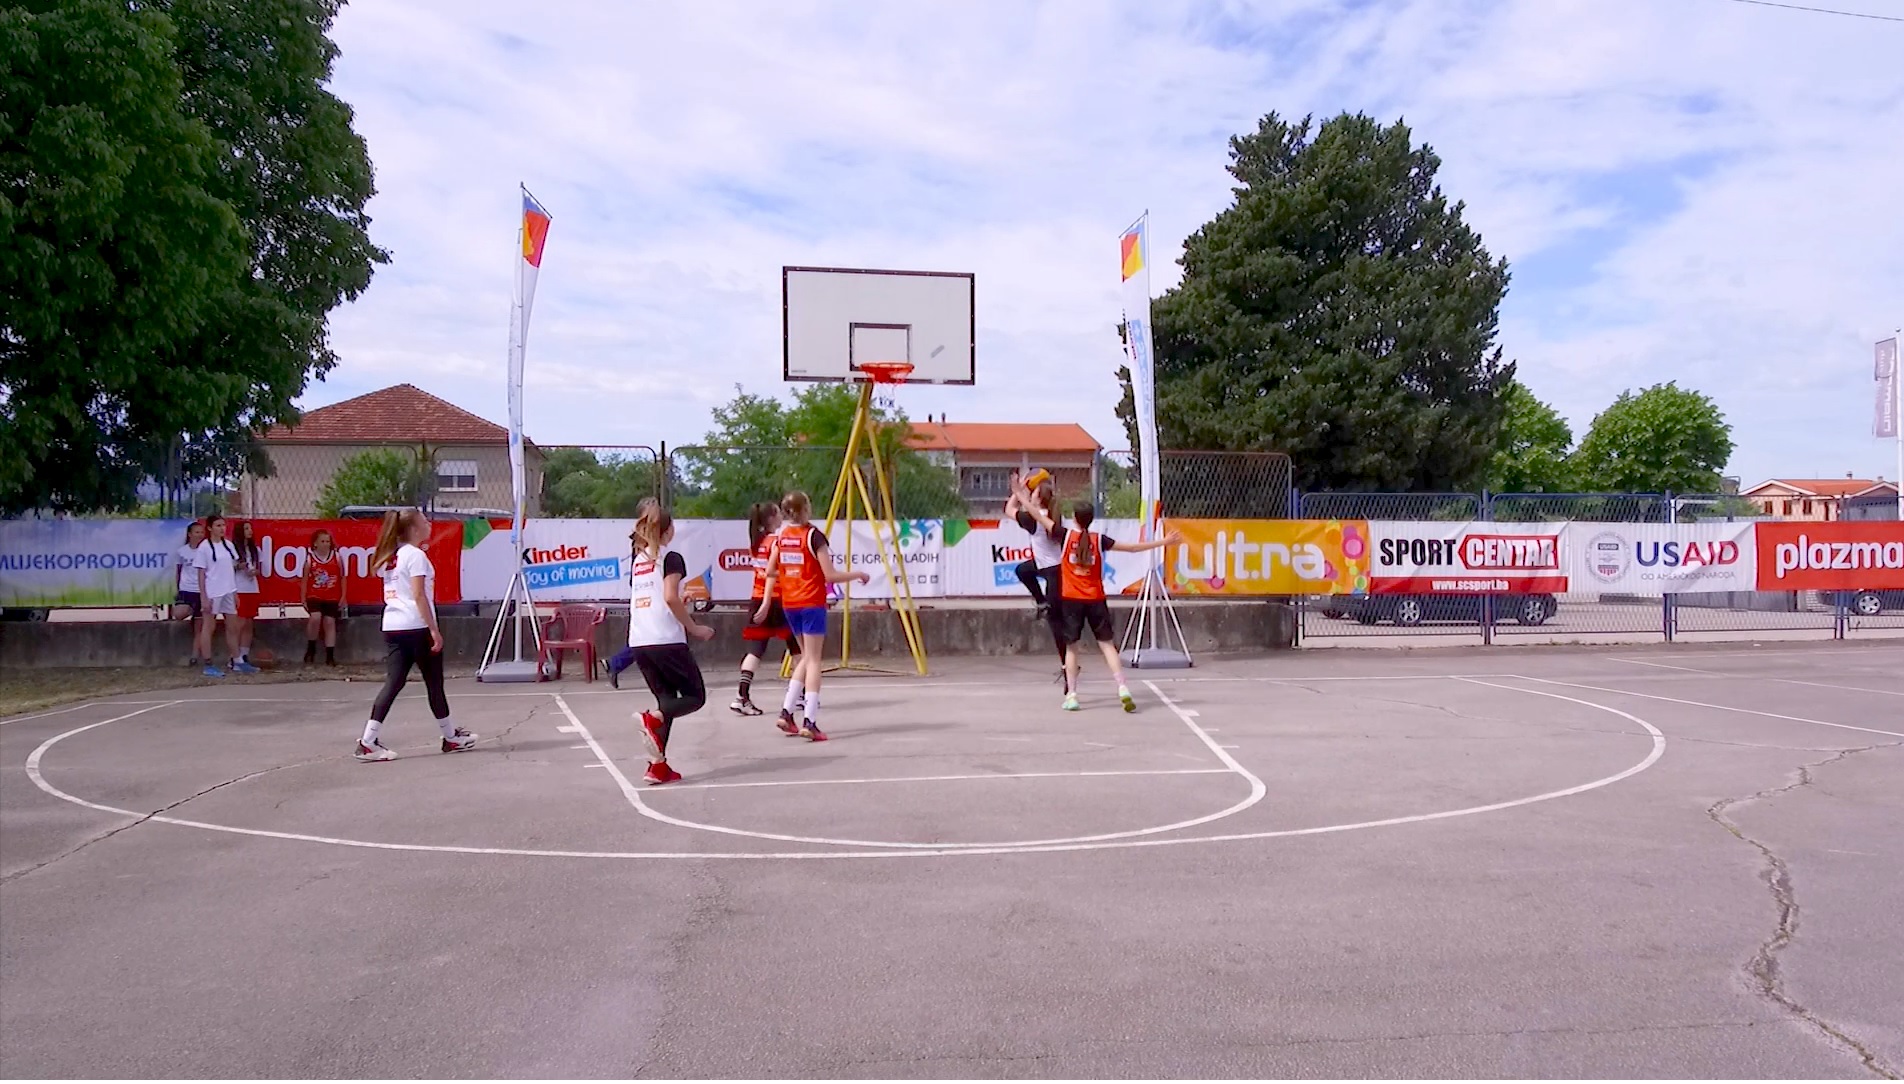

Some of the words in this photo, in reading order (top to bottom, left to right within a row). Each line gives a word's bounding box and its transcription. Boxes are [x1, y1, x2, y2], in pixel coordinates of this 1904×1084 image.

[991, 544, 1036, 563] Kind
[1178, 530, 1326, 580] ultra
[1380, 538, 1456, 566] SPORT
[1466, 538, 1556, 567] CENTAR
[1636, 541, 1739, 567] USAID
[1776, 534, 1904, 579] plazma
[550, 566, 566, 582] of
[568, 563, 617, 580] moving
[1431, 579, 1509, 591] www.scsport.ba
